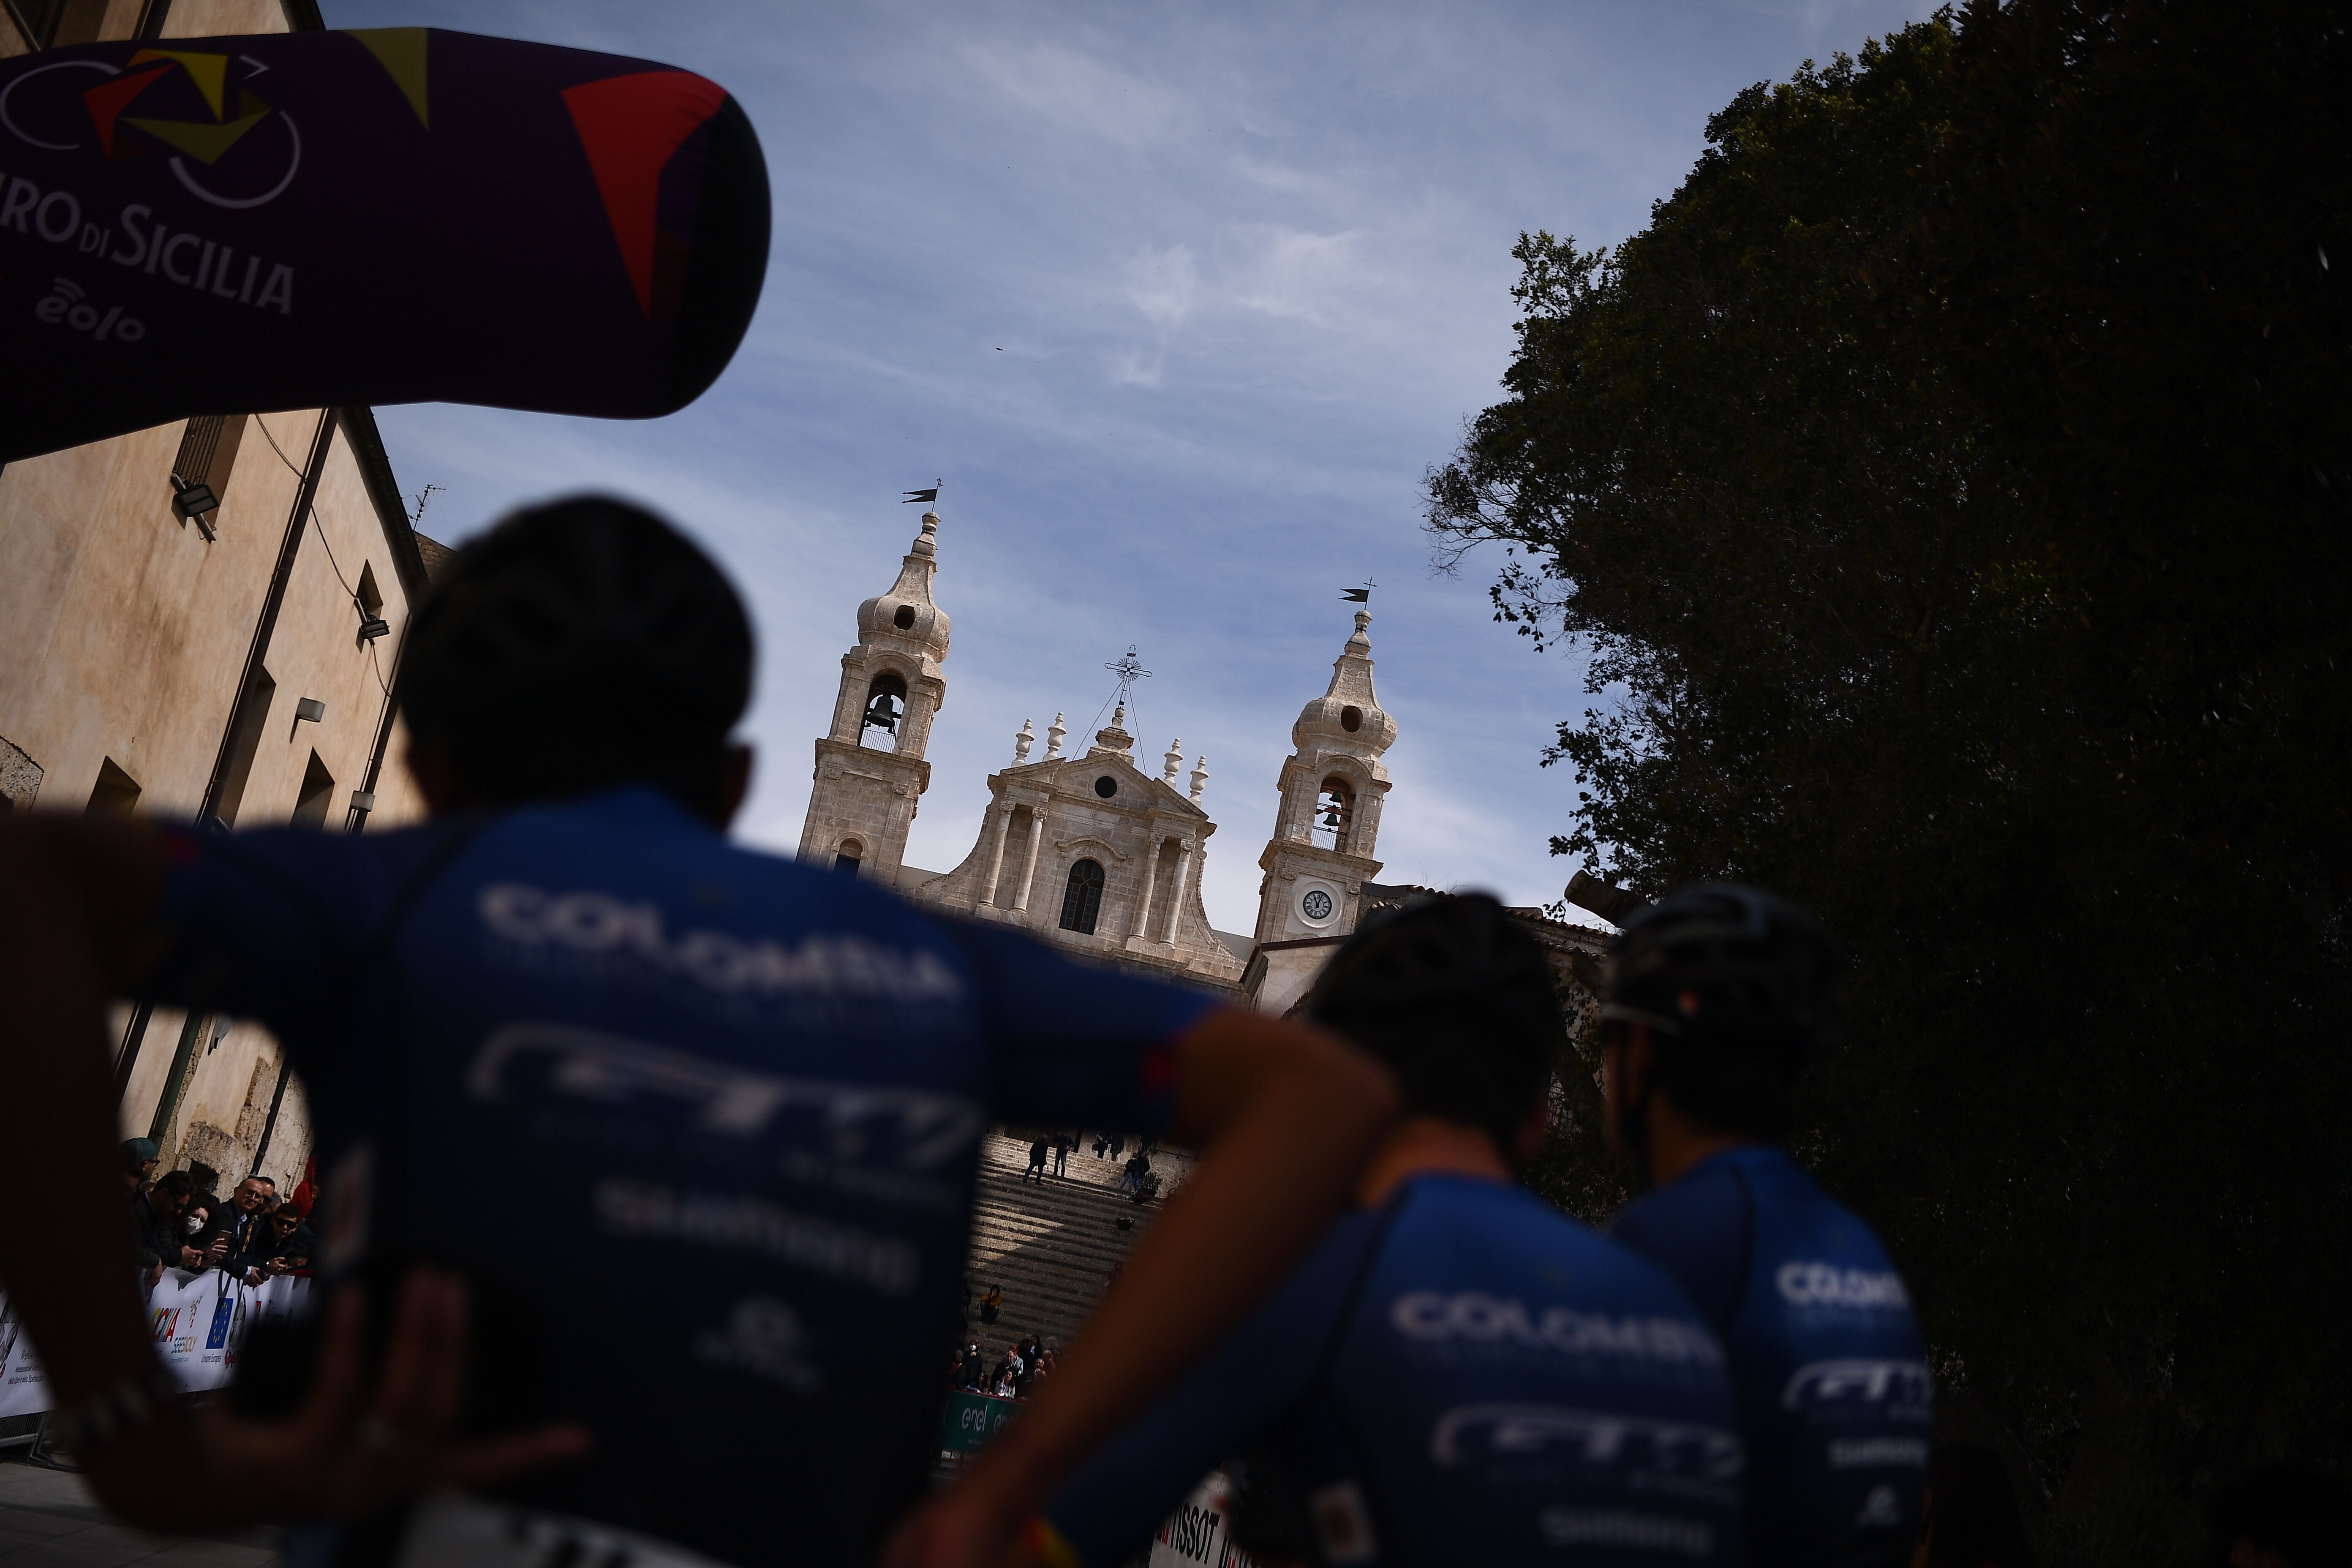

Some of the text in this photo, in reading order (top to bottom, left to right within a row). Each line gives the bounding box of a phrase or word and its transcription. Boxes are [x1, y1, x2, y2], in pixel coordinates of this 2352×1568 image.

[78, 222, 111, 258] DI
[110, 203, 295, 316] SICILIA
[35, 295, 146, 342] eolo
[961, 1405, 988, 1432] enel
